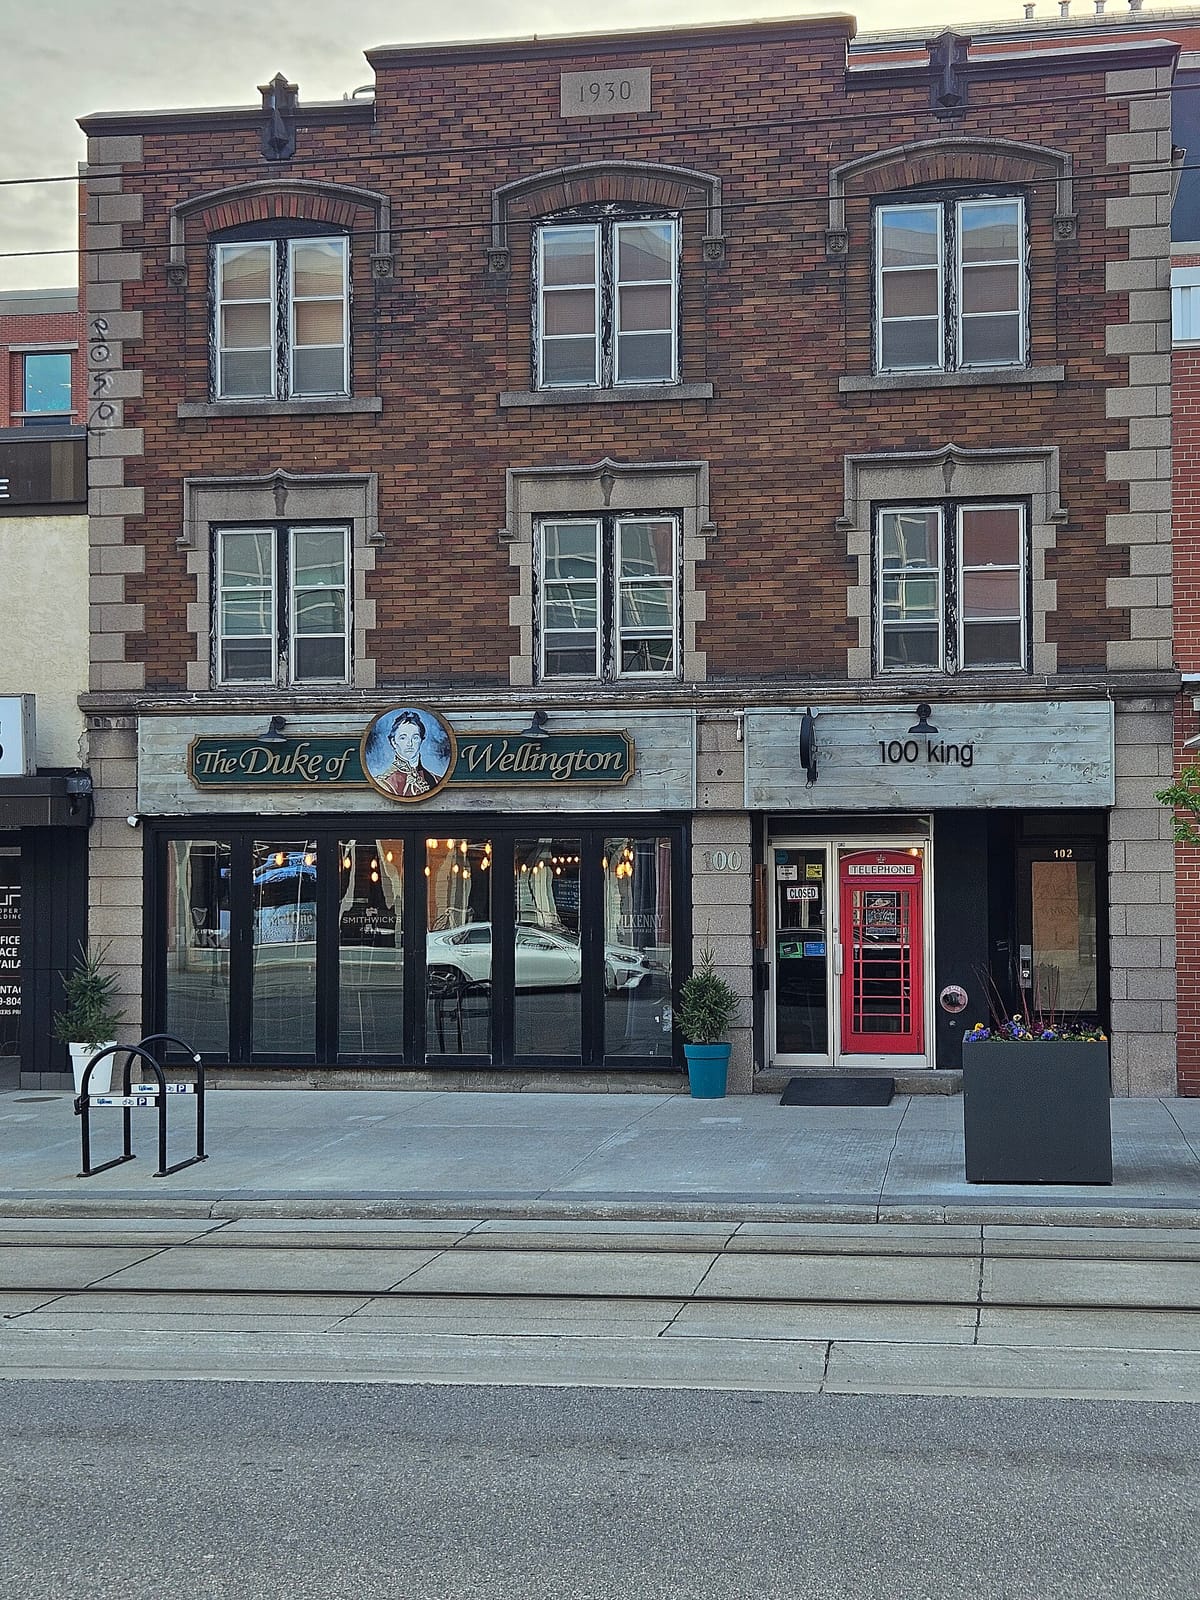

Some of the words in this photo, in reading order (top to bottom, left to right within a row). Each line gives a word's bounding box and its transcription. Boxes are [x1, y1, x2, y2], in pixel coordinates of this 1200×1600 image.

[580, 81, 631, 103] 1930
[196, 749, 237, 774] The
[239, 742, 323, 781] Duke
[325, 748, 355, 780] of
[461, 739, 623, 780] Wellington
[878, 740, 919, 763] 100
[927, 740, 973, 768] king
[703, 850, 742, 871] 100
[1053, 848, 1073, 858] 102
[853, 865, 912, 874] TELEPHONE
[789, 888, 816, 899] CLOSED
